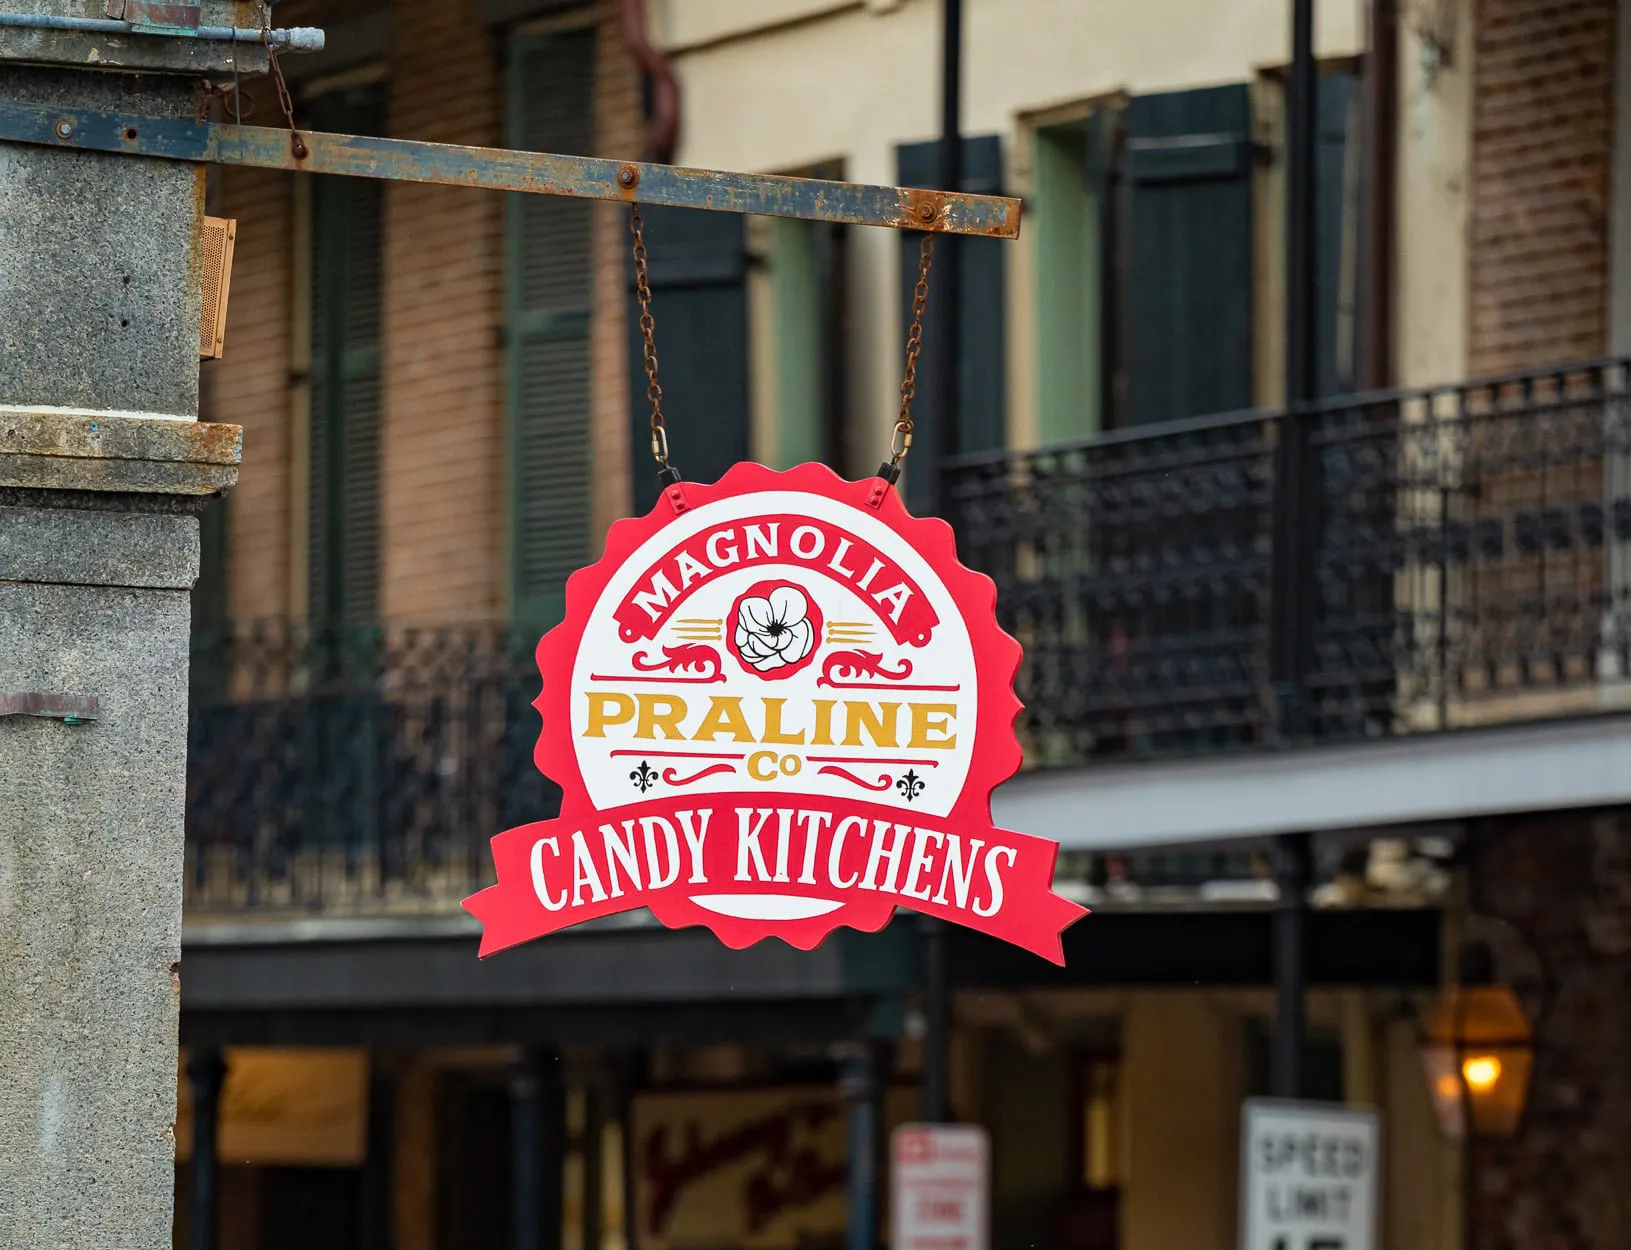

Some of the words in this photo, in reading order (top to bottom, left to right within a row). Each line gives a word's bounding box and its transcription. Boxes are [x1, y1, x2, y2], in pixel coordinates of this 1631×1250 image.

[631, 522, 914, 625] MAGNOLIA
[582, 692, 958, 749] PRALINE
[530, 808, 713, 912] CANDY
[733, 807, 1017, 917] KITCHENS
[1261, 1133, 1365, 1178] SPEED
[1265, 1185, 1351, 1224] LIMIT
